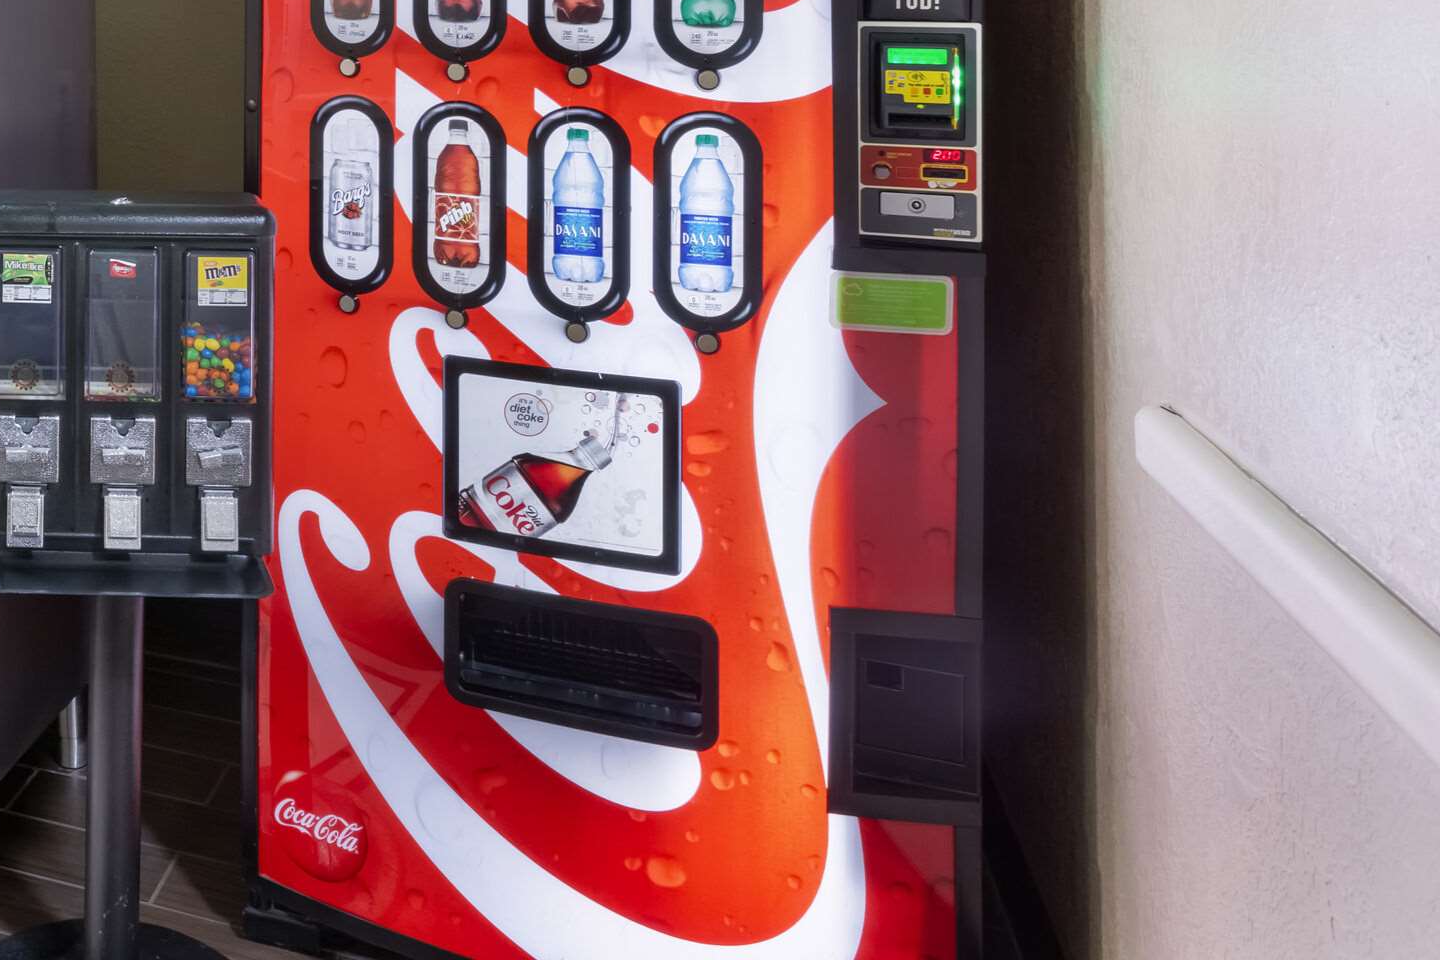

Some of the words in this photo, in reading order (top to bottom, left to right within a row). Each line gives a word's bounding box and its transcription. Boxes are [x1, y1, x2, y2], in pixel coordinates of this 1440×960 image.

[440, 201, 473, 232] Pibb
[555, 223, 601, 238] DASANI
[682, 232, 730, 247] DASANI
[4, 260, 28, 270] Mike
[510, 403, 531, 414] diet
[513, 420, 530, 428] thing
[517, 412, 544, 423] coke
[486, 474, 535, 536] Coke
[274, 798, 363, 852] Coca-Cola
